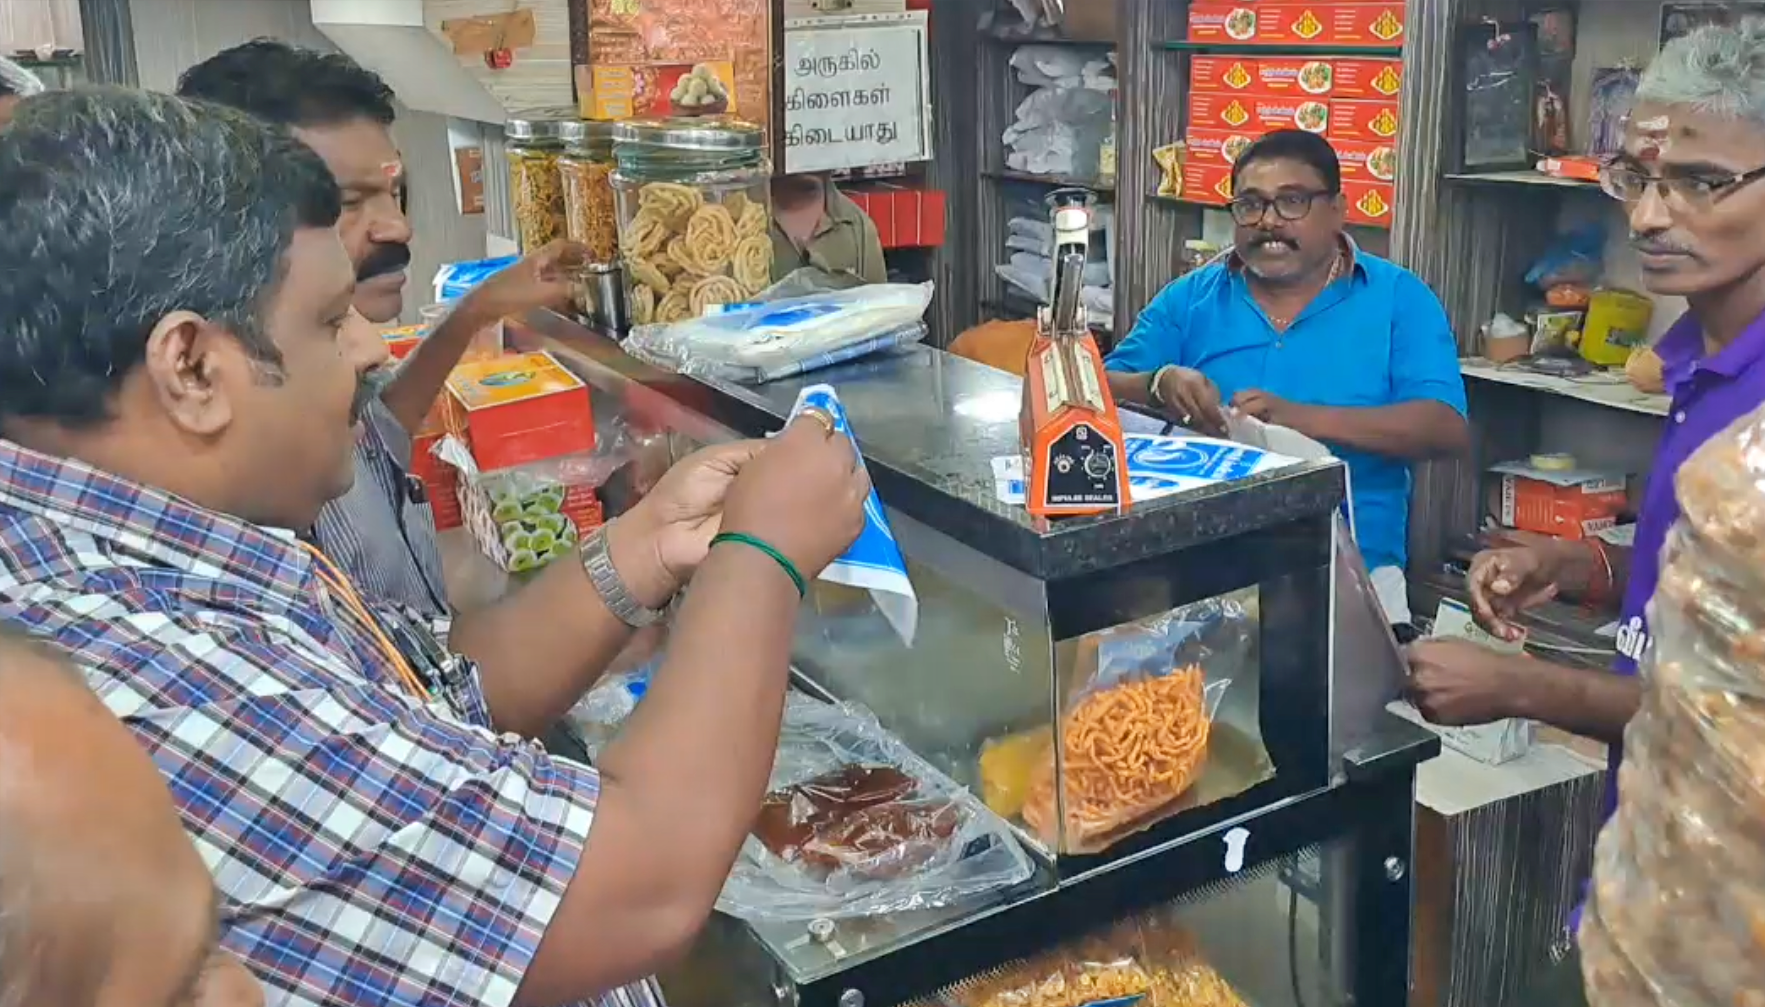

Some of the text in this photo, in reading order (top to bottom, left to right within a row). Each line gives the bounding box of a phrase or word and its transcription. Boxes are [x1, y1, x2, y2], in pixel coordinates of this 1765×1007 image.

[794, 48, 881, 77] அருகில்
[785, 83, 888, 111] கிளைகள்
[784, 121, 896, 147] கிடையாது
